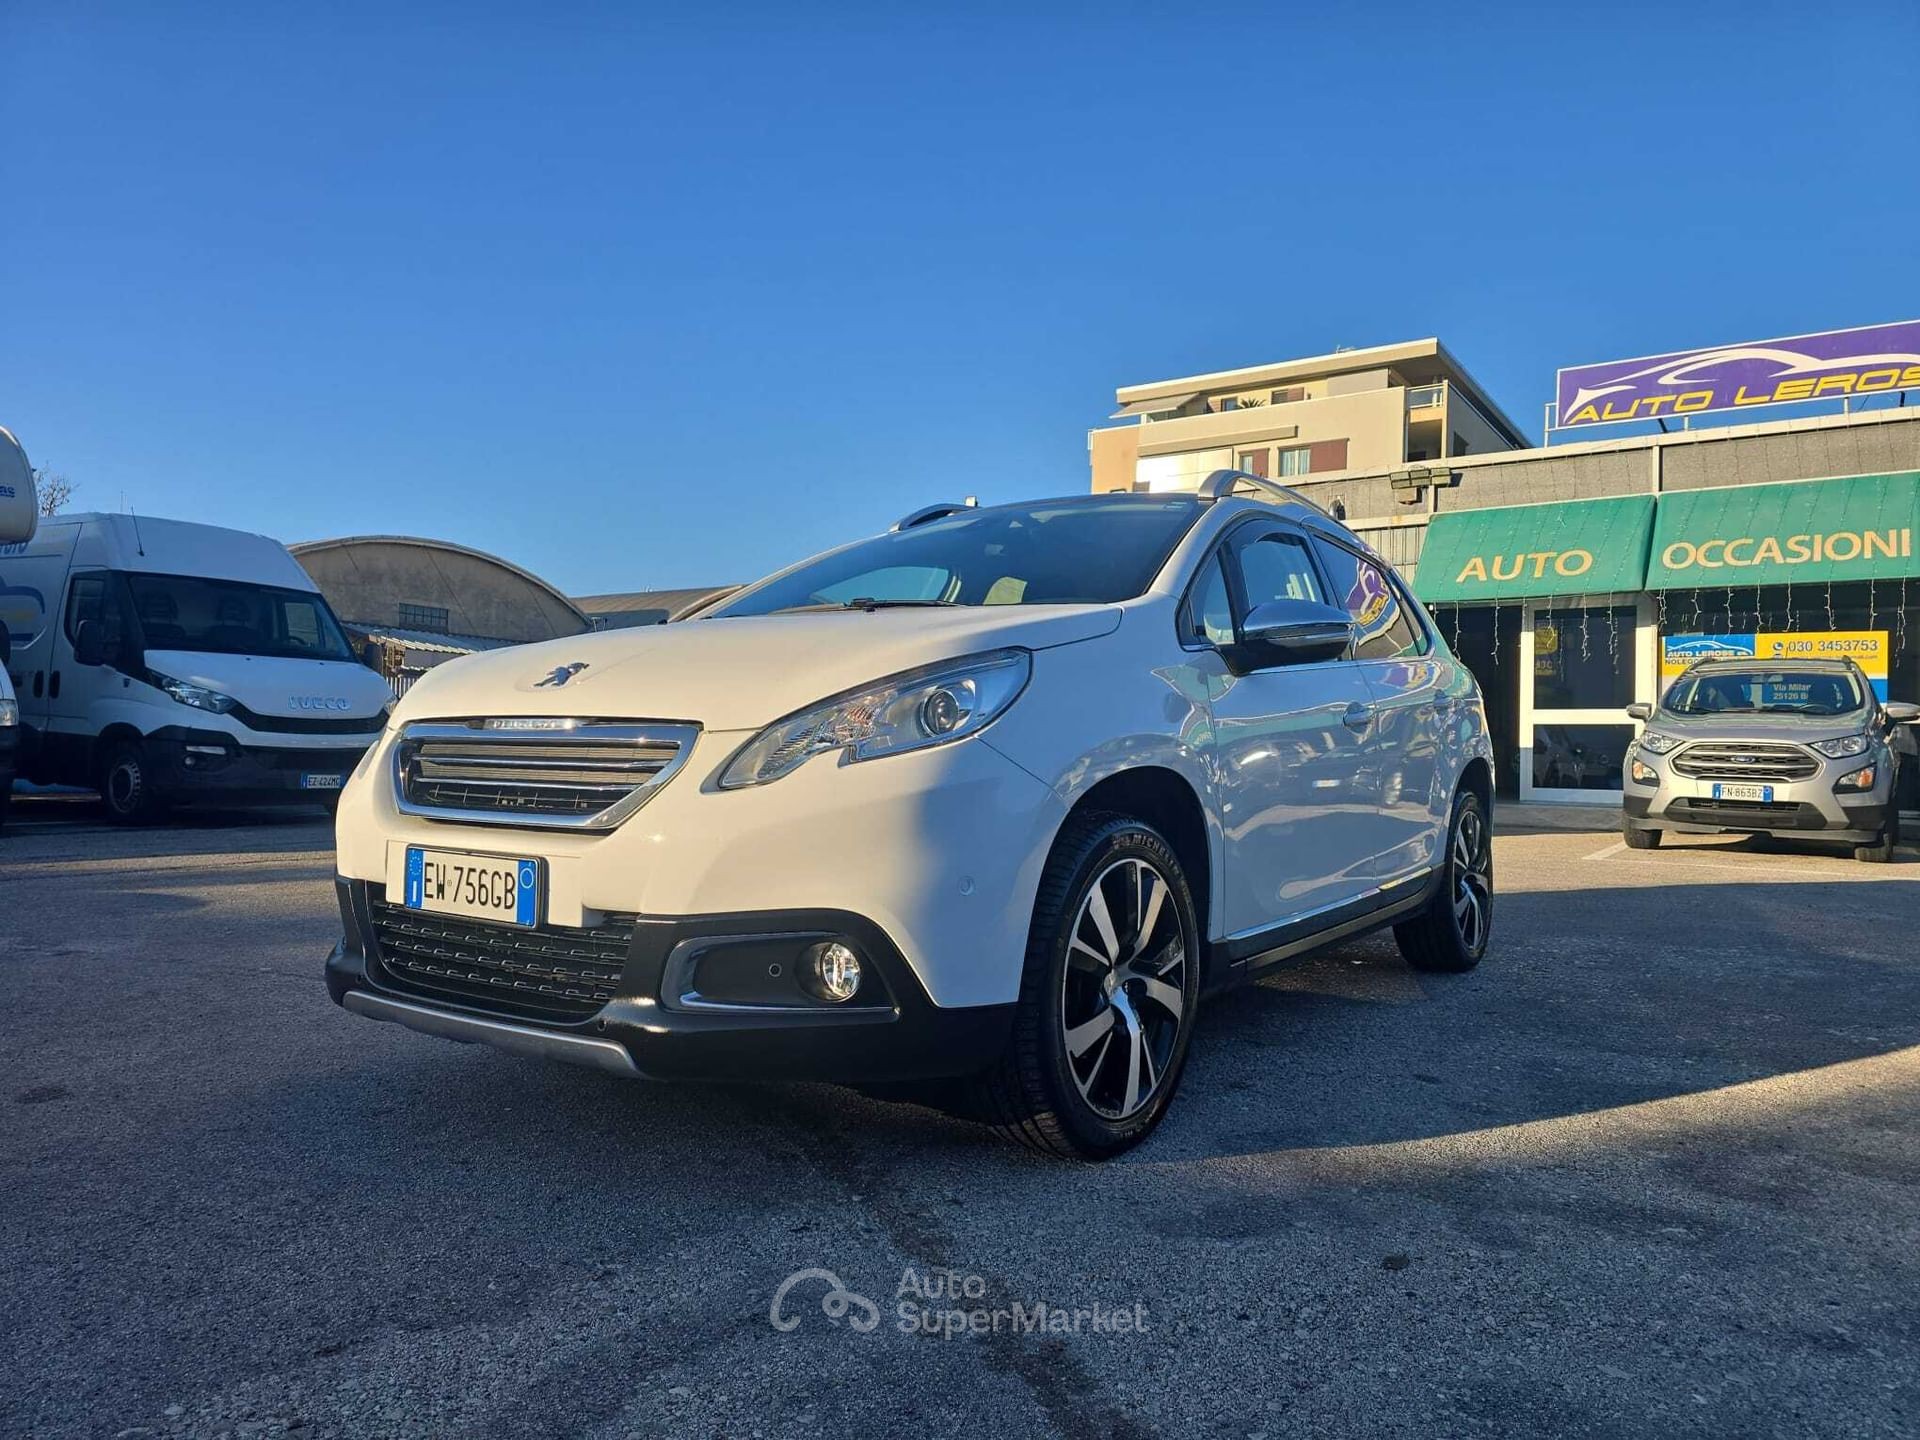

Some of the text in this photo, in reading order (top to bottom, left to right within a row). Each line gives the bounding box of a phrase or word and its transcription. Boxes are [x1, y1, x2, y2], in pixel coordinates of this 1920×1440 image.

[1568, 390, 1714, 425] AUTO
[1455, 549, 1594, 584] AUTO
[1662, 528, 1911, 570] OCCASIONI
[1788, 639, 1879, 652] 030 3453753
